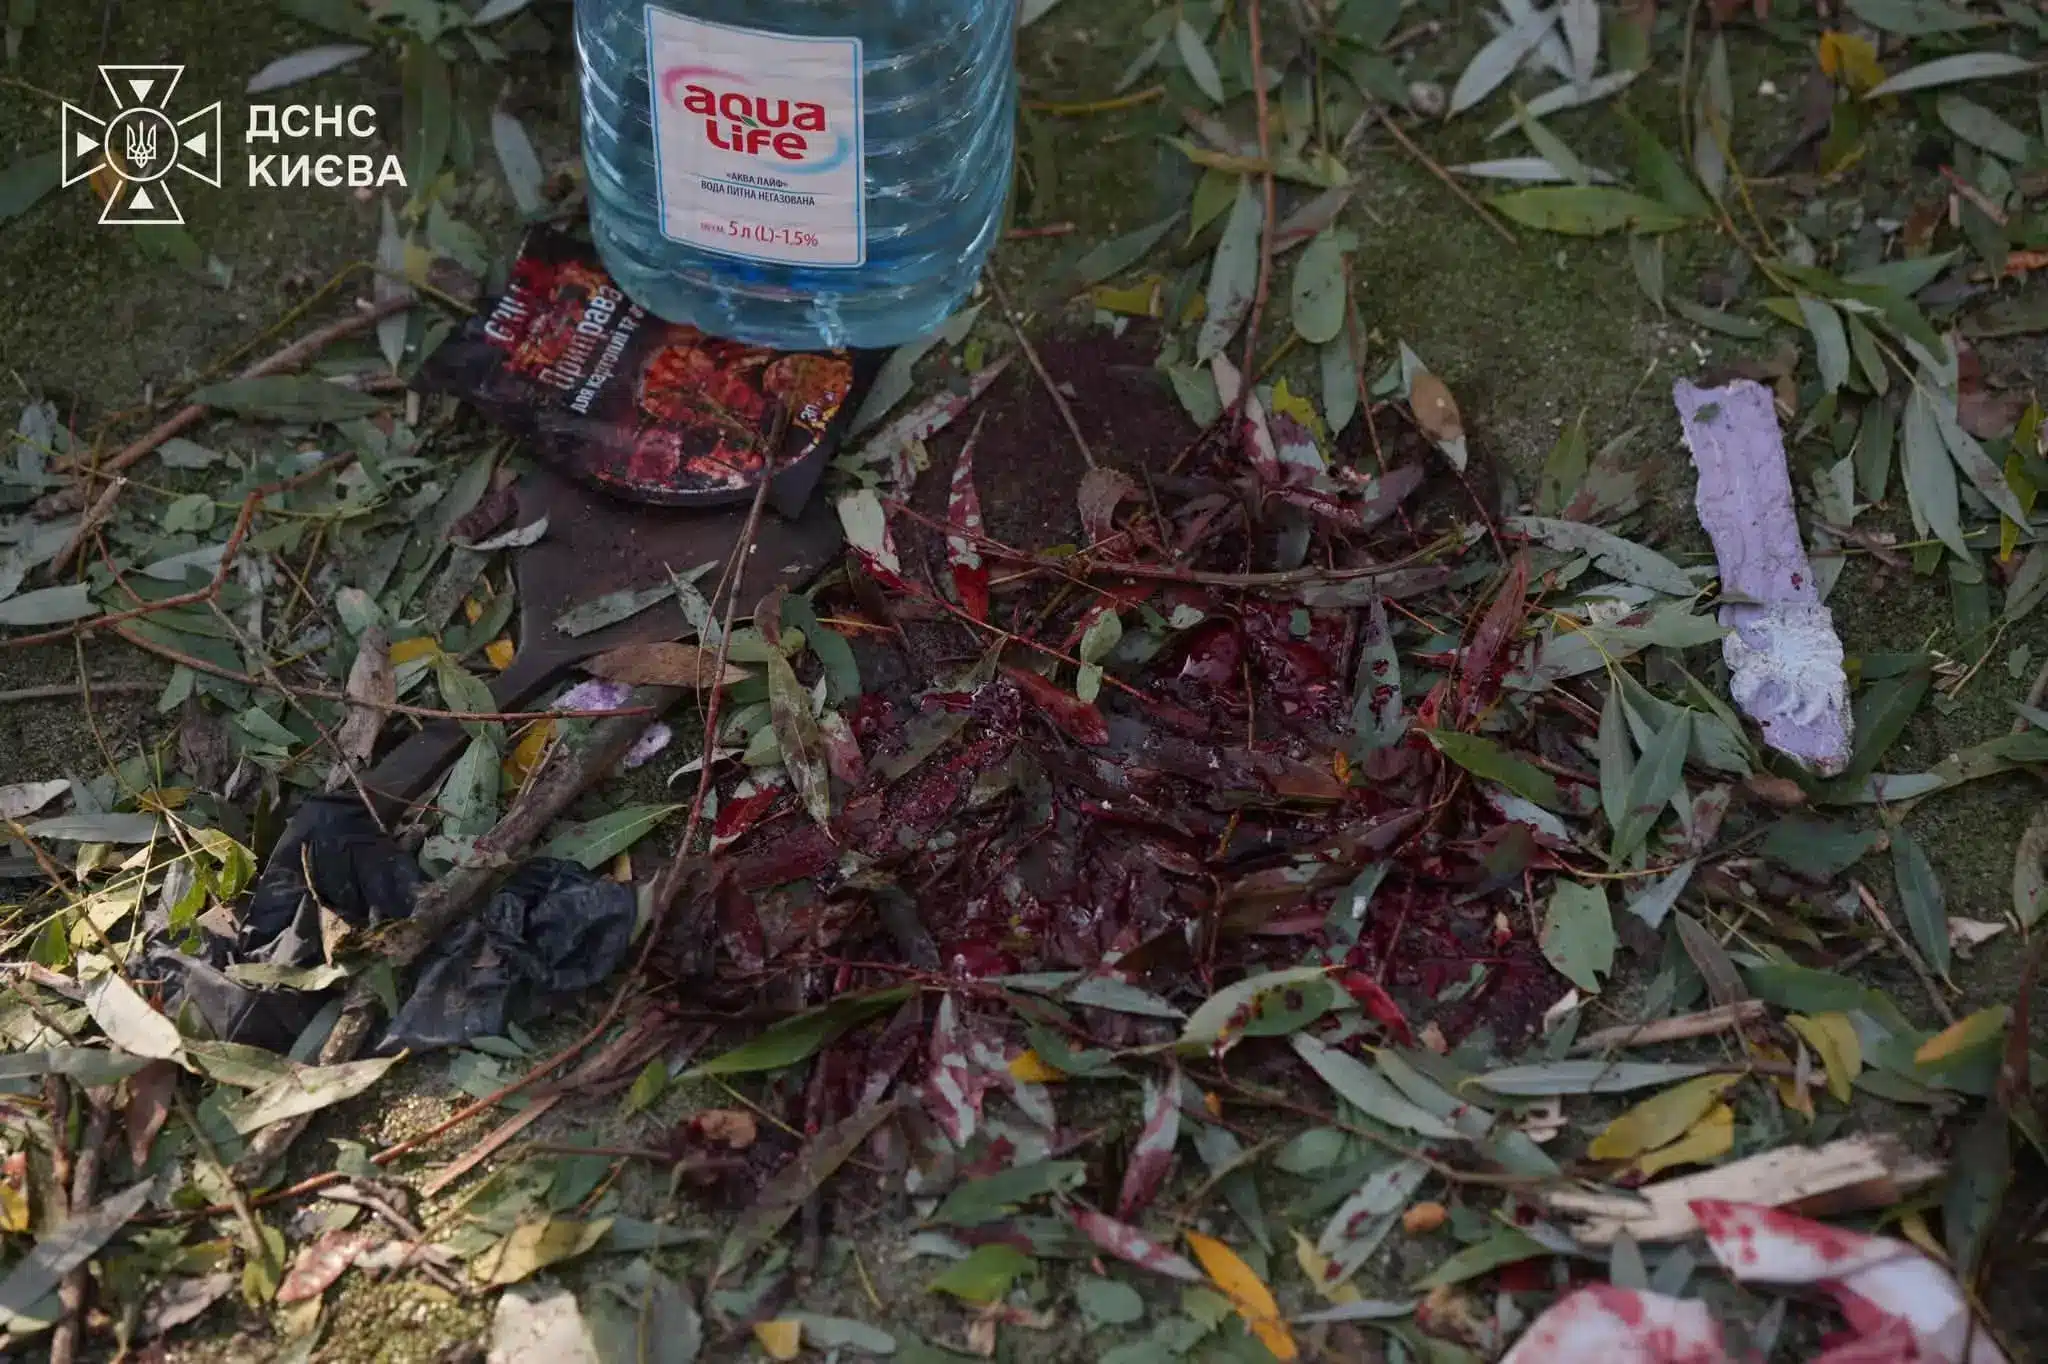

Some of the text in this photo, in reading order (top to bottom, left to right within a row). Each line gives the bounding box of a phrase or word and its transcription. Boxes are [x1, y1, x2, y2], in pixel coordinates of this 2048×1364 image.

[683, 85, 826, 132] aqua
[701, 180, 815, 206] ВОДА ПИТНА НЕГАЗОВАНА
[728, 220, 738, 236] 5
[741, 226, 751, 239] л
[538, 285, 623, 391] Приправа
